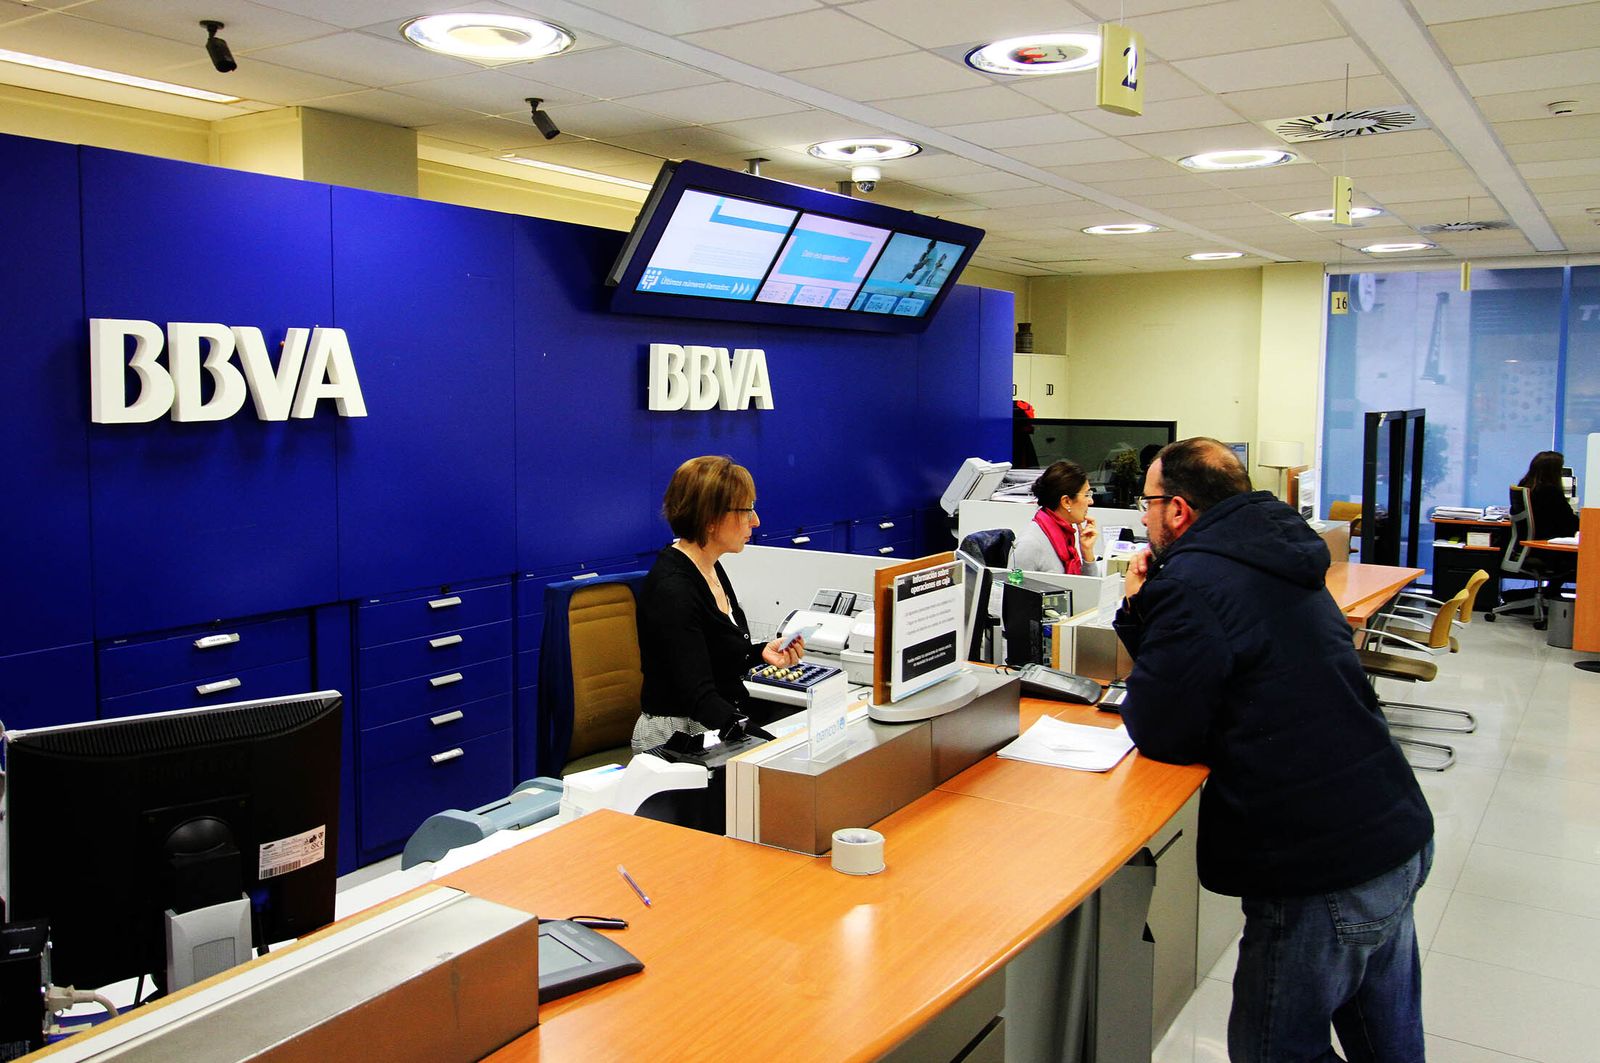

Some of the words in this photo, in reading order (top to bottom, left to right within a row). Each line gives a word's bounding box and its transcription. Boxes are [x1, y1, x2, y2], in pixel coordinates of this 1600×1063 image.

[1336, 297, 1348, 310] 16
[89, 317, 367, 425] BBVA
[648, 343, 774, 411] BBVA
[912, 571, 937, 584] Información
[938, 568, 949, 577] sobre
[910, 582, 936, 595] operaciones
